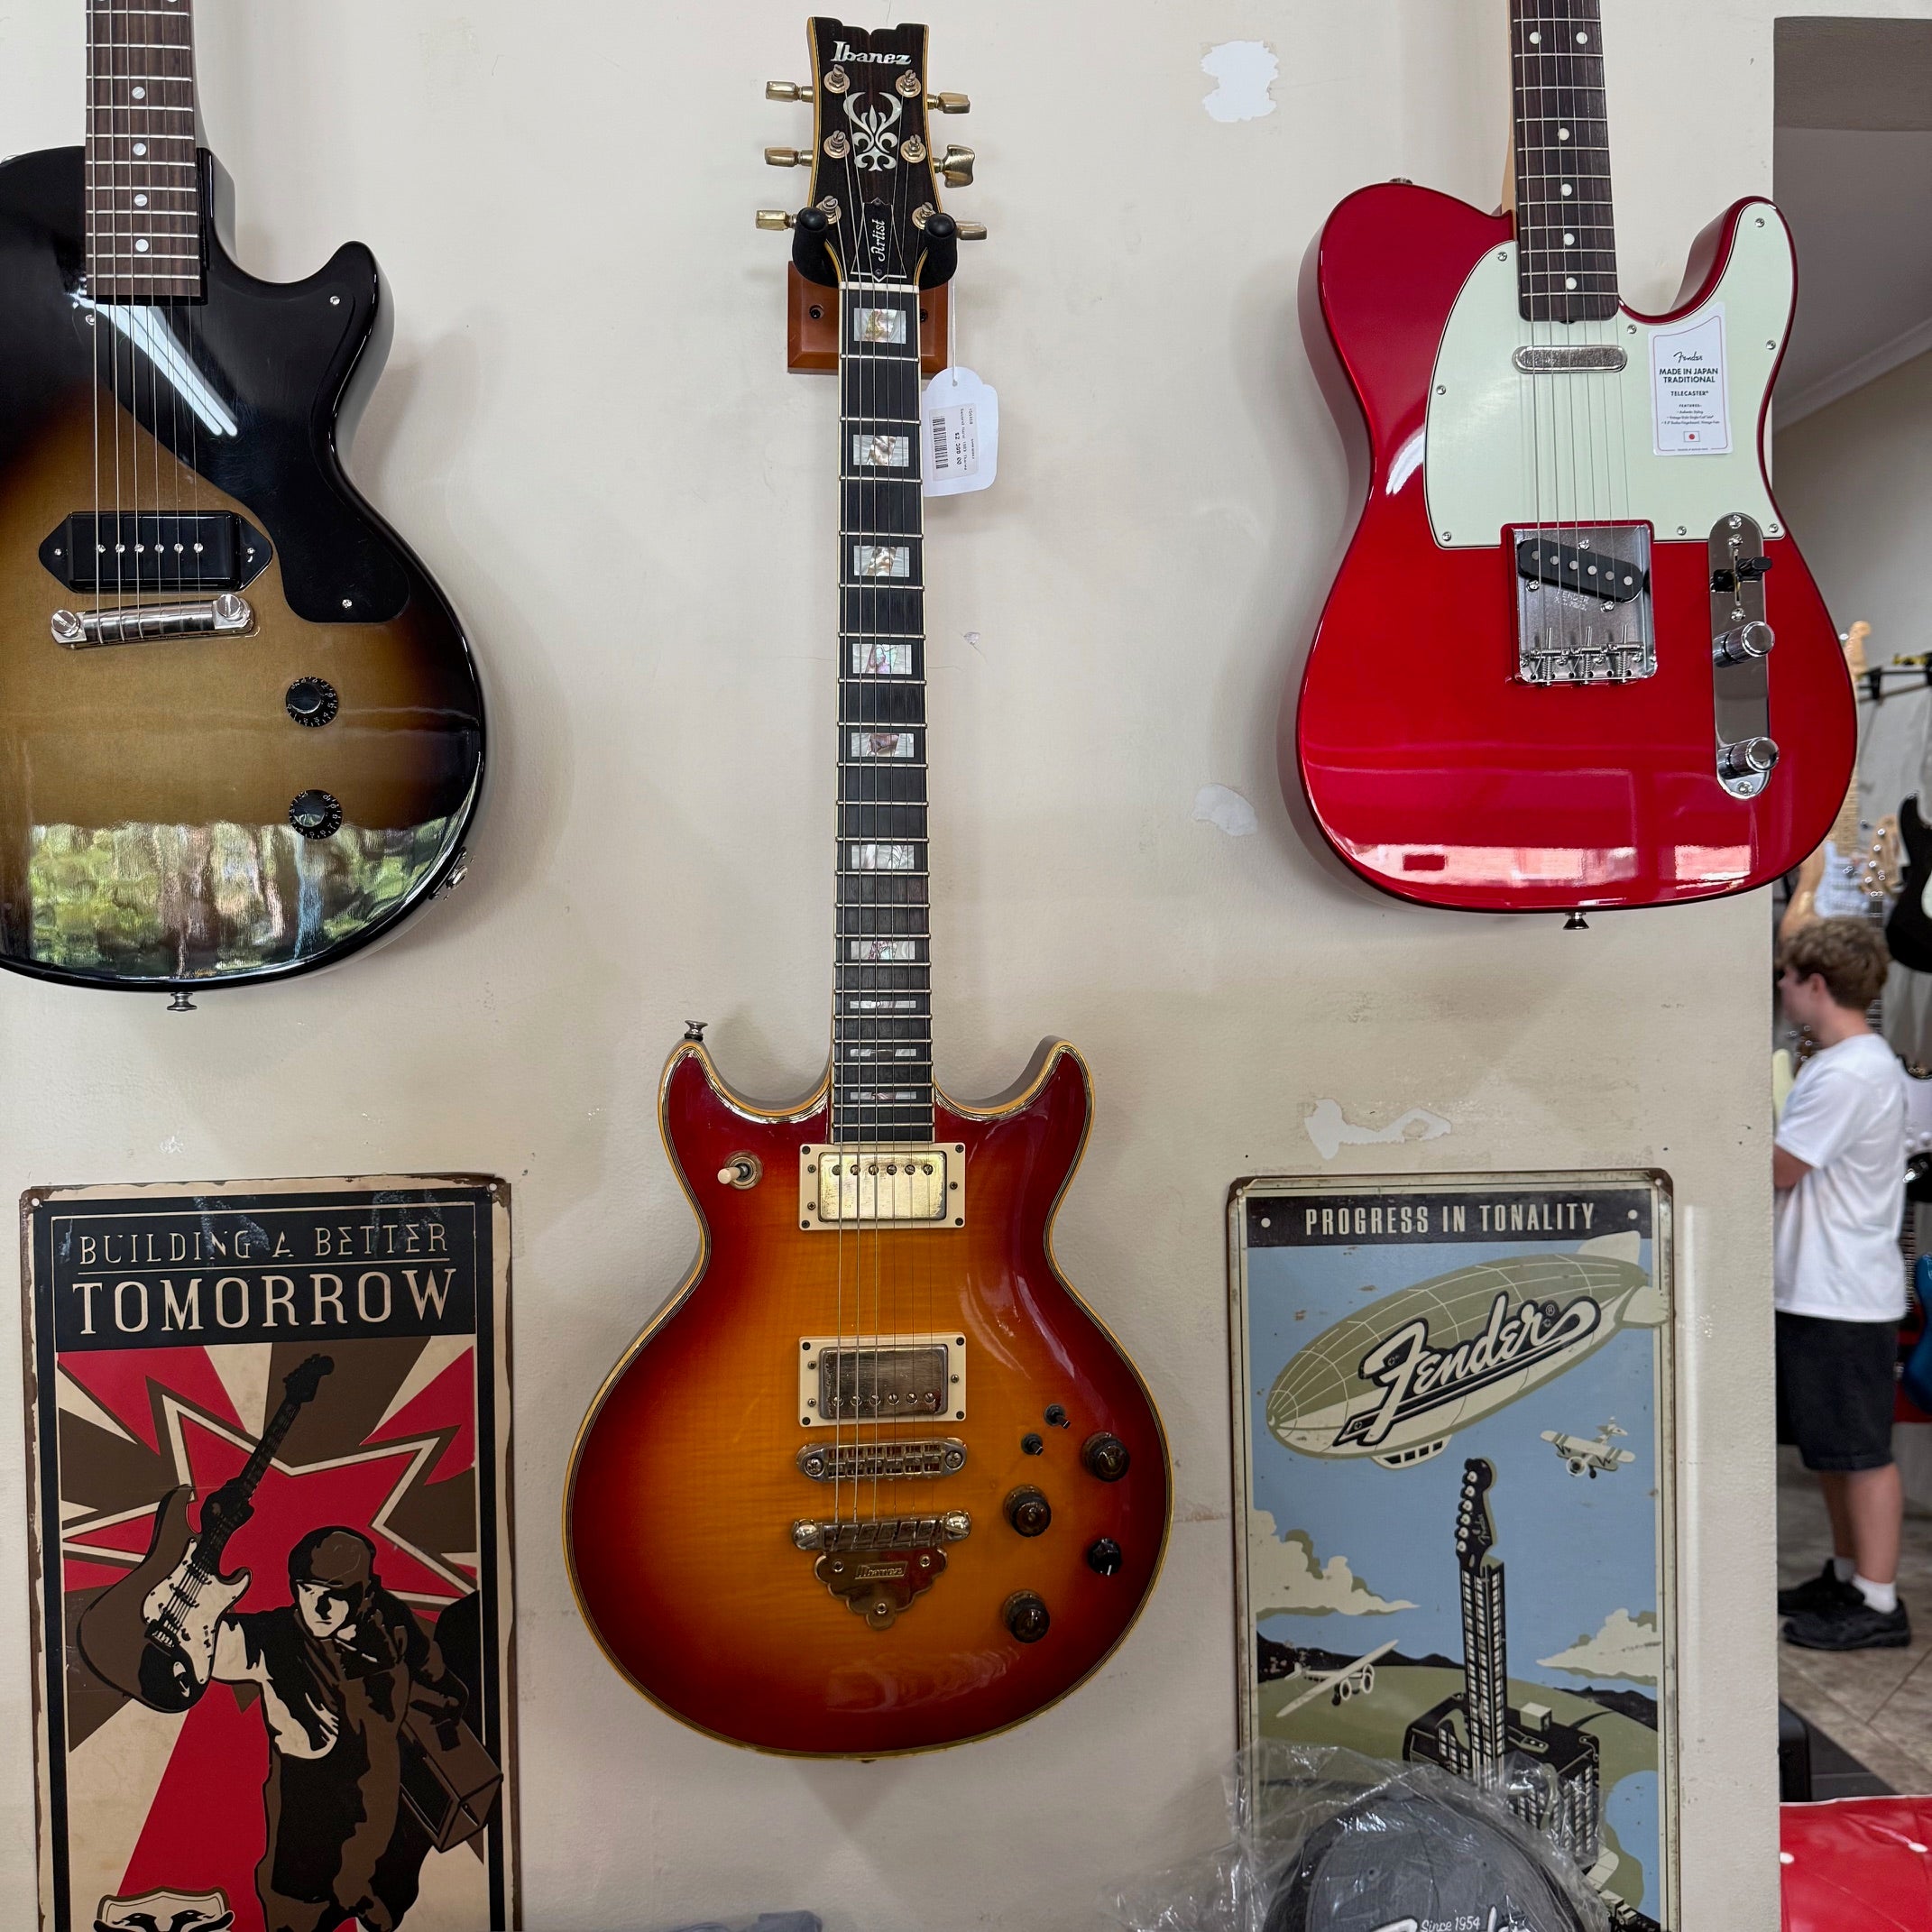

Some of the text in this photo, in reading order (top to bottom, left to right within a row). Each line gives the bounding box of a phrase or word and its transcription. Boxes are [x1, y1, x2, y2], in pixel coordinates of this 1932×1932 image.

[830, 41, 912, 65] Ibanez
[870, 218, 886, 262] Artist
[1673, 351, 1703, 363] Fender
[1694, 367, 1718, 375] JAPAN
[1305, 1202, 1596, 1236] PROGRESS IN TONALITY
[79, 1223, 448, 1265] BUILDING A BETTER
[72, 1268, 456, 1335] TOMORROW
[1421, 1919, 1452, 1932] Since
[1455, 1916, 1481, 1931] 1954
